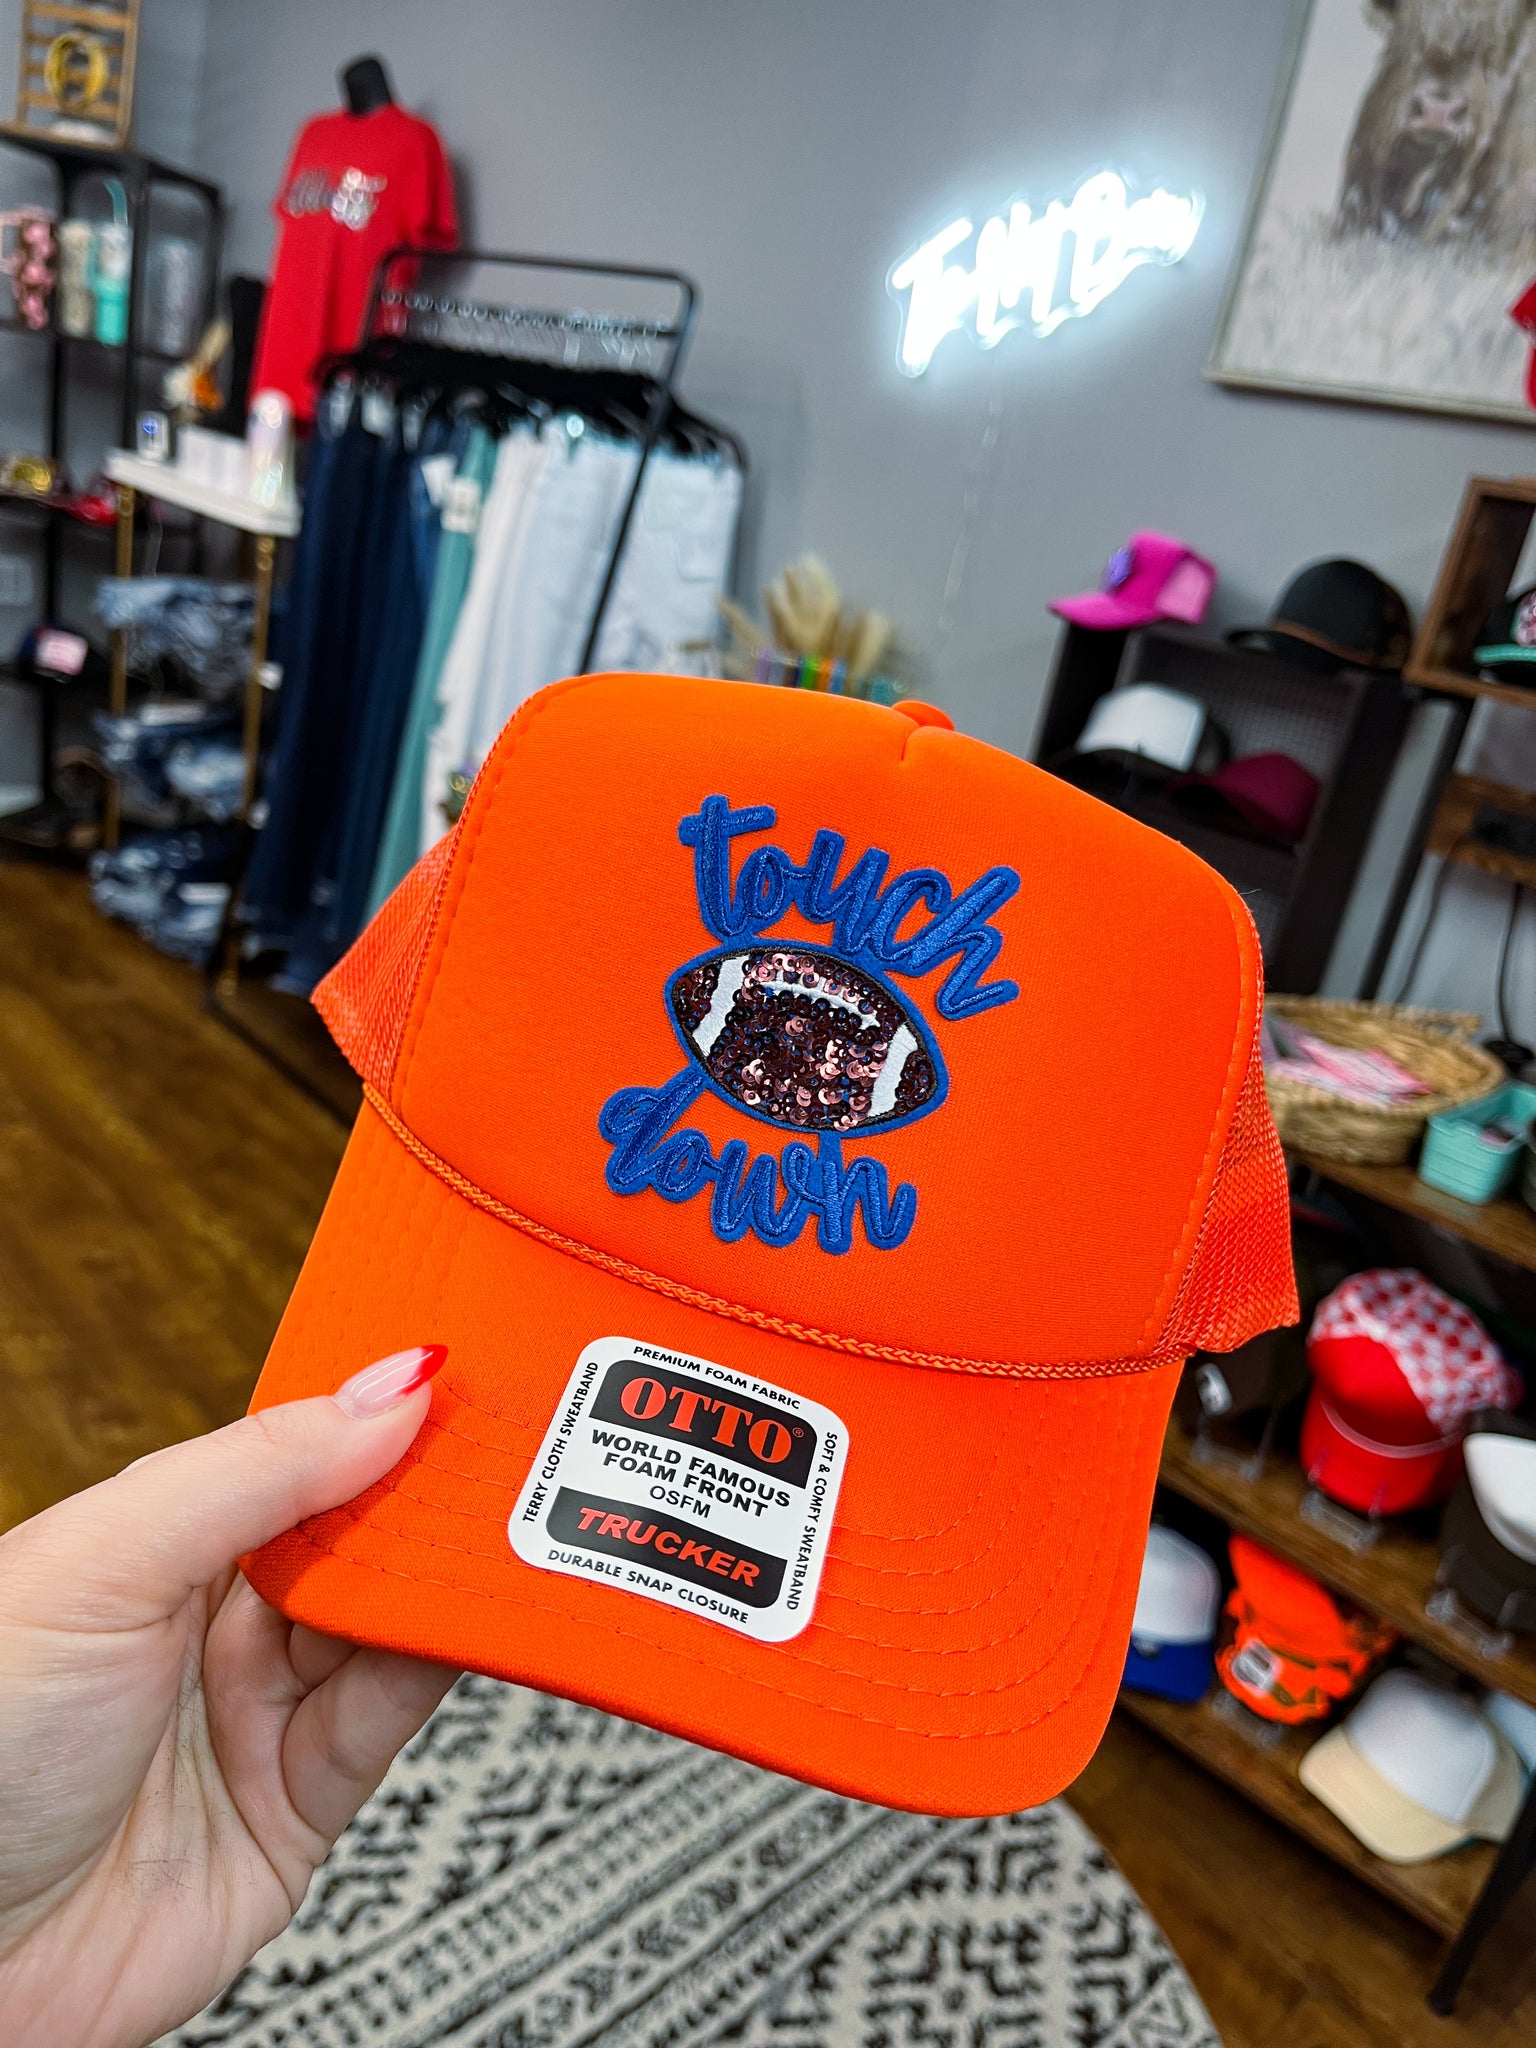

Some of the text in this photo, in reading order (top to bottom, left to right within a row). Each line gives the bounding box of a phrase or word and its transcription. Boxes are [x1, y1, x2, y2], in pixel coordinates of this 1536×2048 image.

[677, 795, 1021, 1020] touch
[598, 1071, 917, 1255] down
[633, 1346, 801, 1409] PREMIUM FOAM FABRIC
[522, 1362, 599, 1523] TERRY CLOTH SWEATBAND
[591, 1429, 791, 1507] WORLD FAMOUS
[602, 1452, 768, 1518] FOAM FRONT
[649, 1485, 711, 1519] OSFM
[786, 1432, 838, 1611] SOFT & COMFY SWEATBAND
[547, 1549, 749, 1624] DURABLE SNAP CLOSURE
[577, 1507, 760, 1588] TRUCKER
